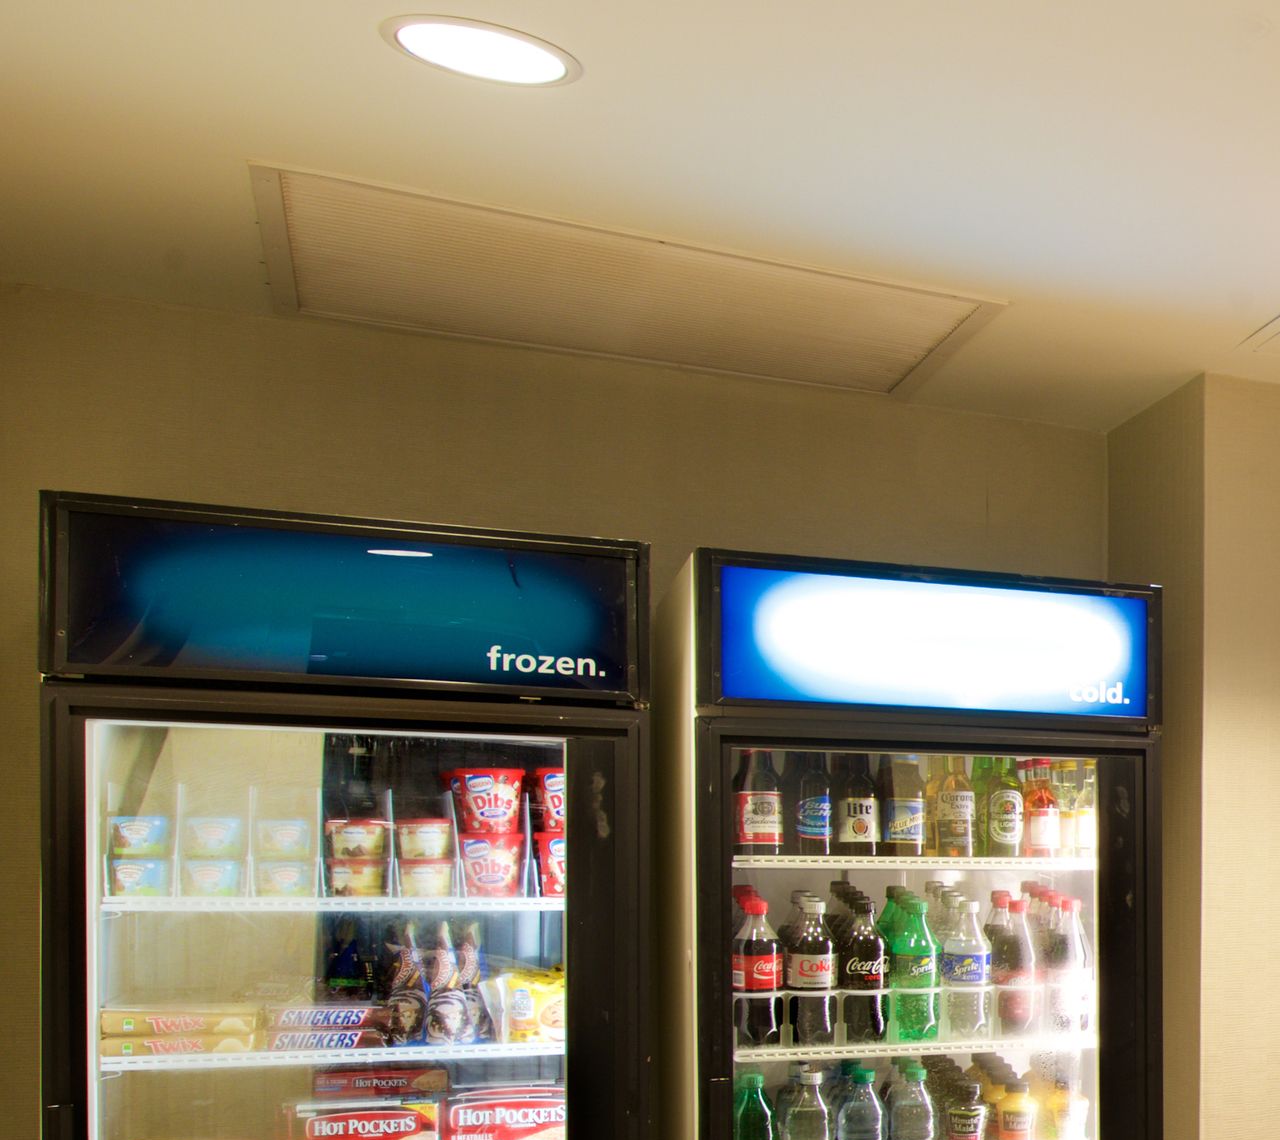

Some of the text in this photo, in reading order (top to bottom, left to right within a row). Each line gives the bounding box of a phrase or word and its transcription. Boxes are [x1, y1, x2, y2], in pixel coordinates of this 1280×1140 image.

[487, 645, 606, 677] frozen.
[1068, 682, 1130, 705] cold.
[473, 794, 512, 811] Dibs
[846, 802, 872, 816] Lite
[472, 859, 511, 878] Dibs
[281, 1009, 369, 1027] SNICKERS
[275, 1032, 359, 1050] SNICKERS
[314, 1117, 416, 1137] HOT POCKETS
[458, 1108, 488, 1127] HOT
